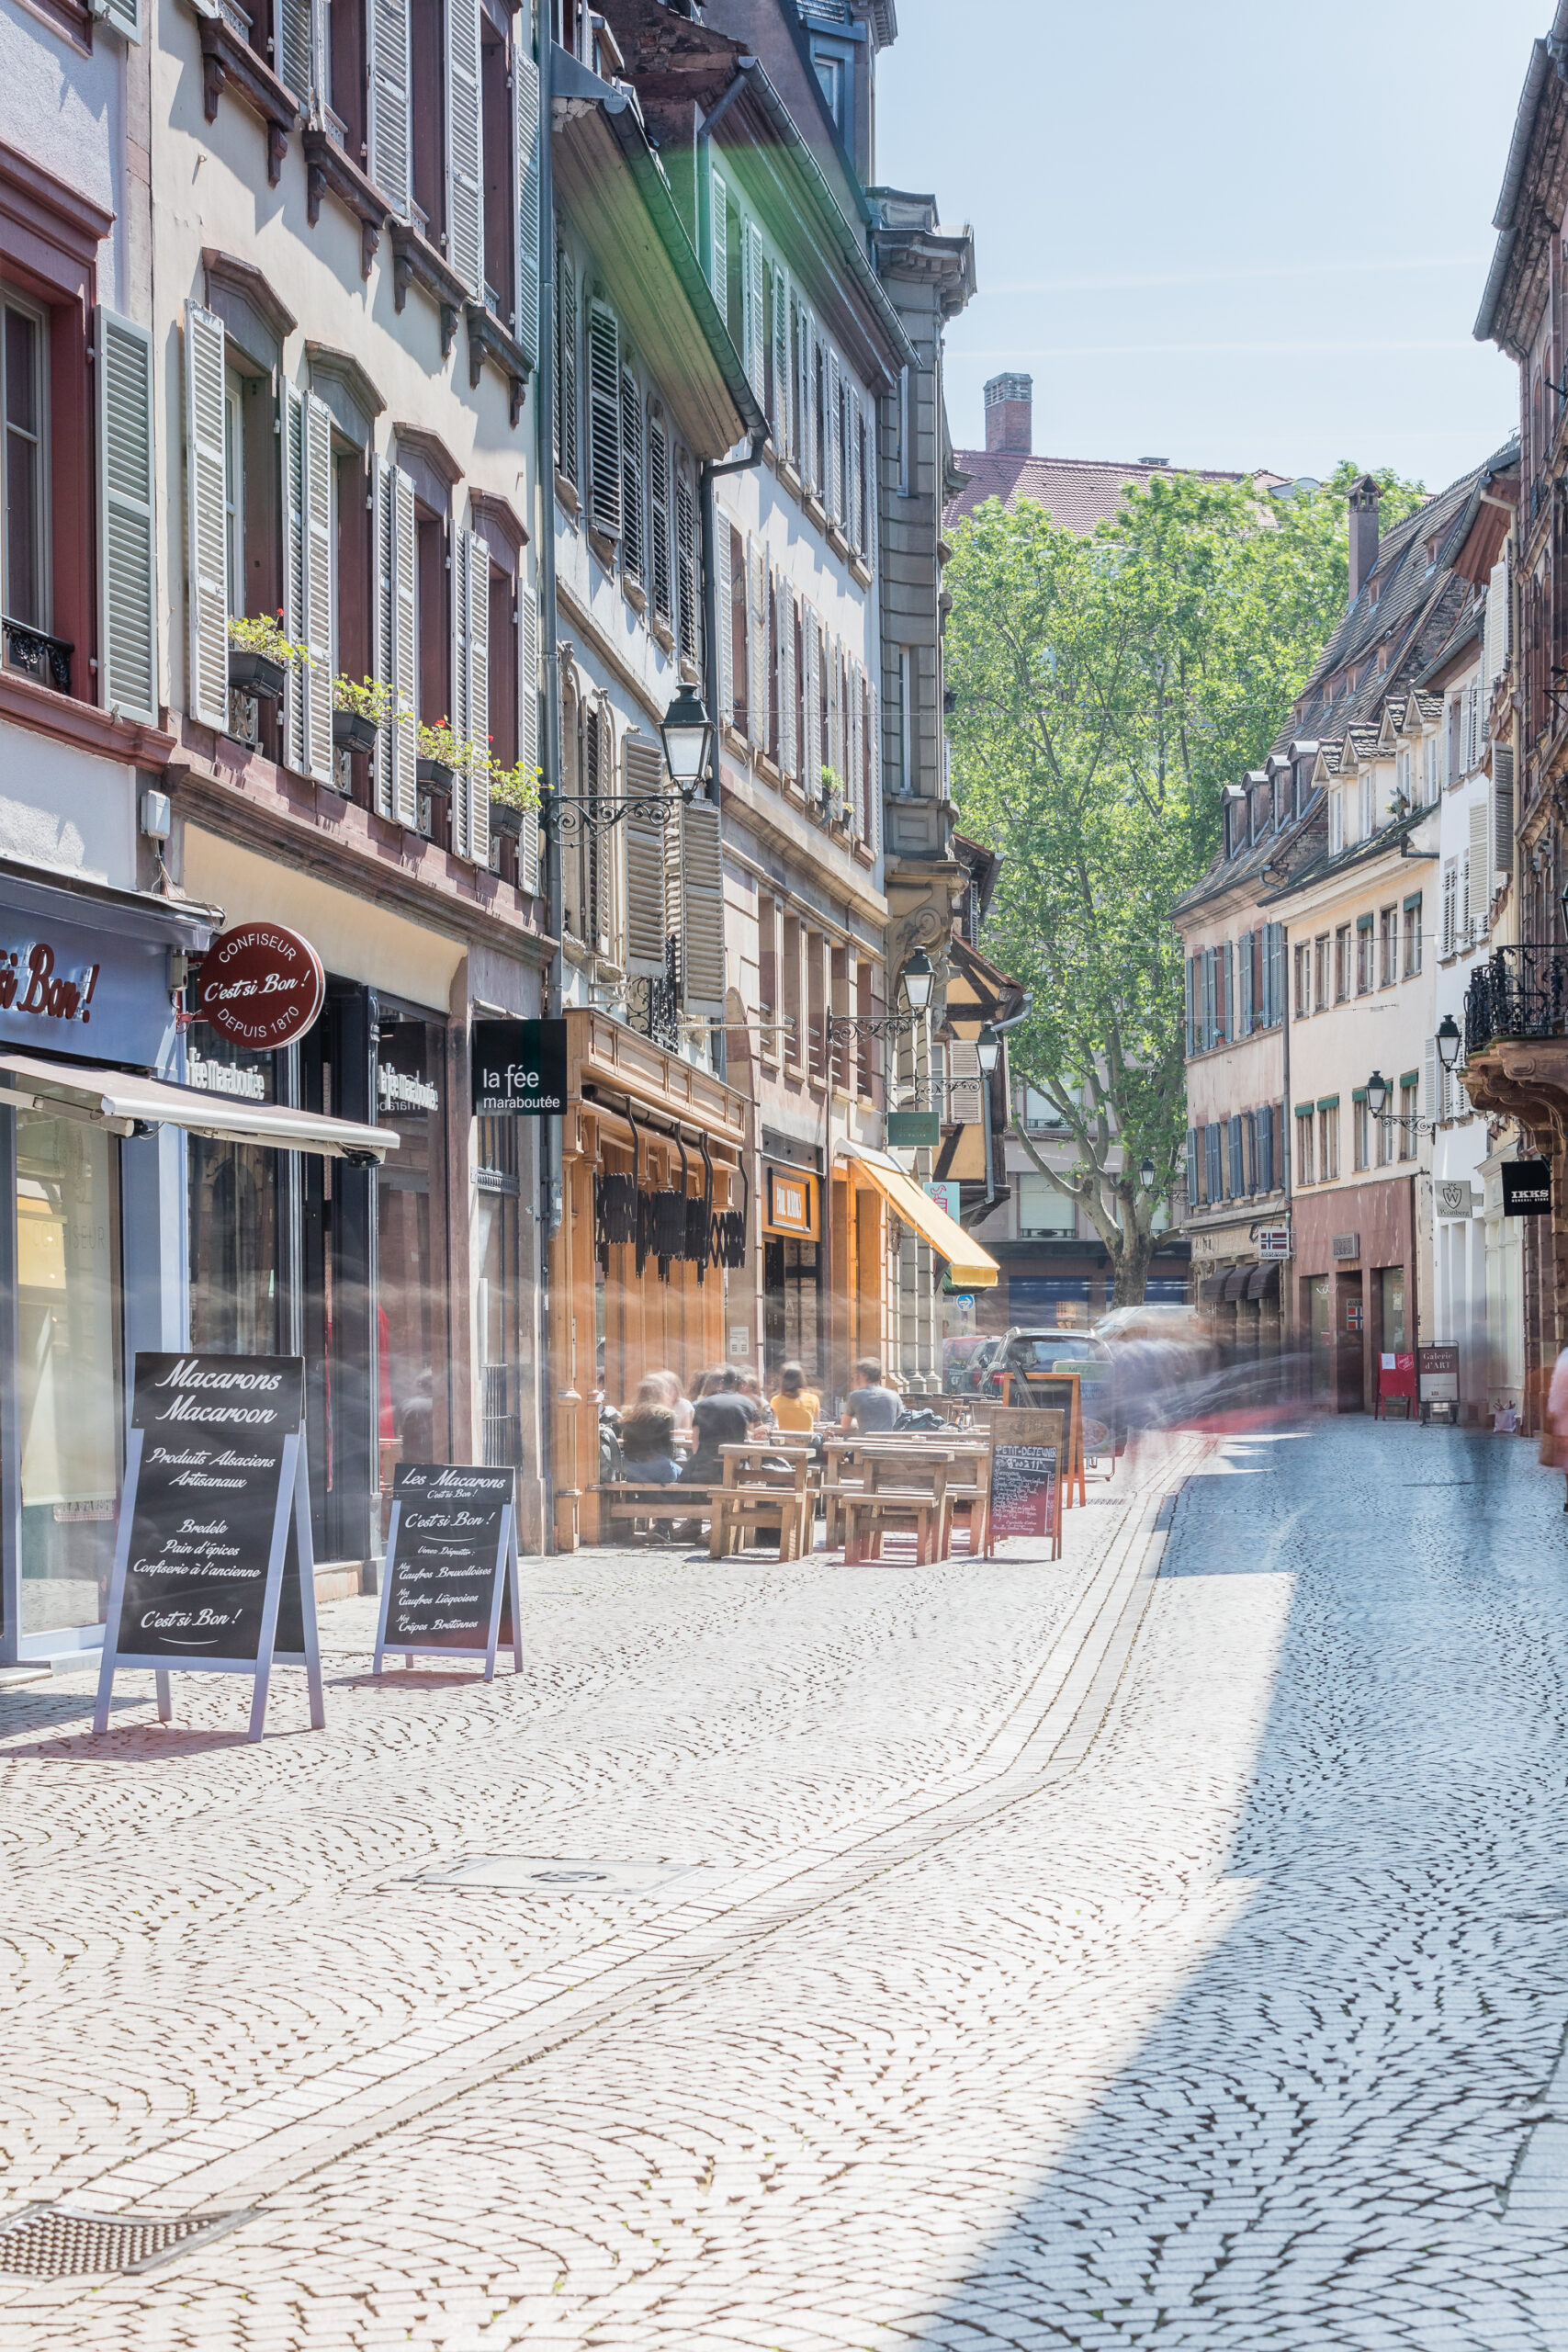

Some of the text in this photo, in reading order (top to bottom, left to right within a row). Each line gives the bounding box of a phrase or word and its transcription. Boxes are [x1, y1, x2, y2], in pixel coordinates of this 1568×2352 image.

[219, 933, 297, 963] CONFISEUR
[204, 969, 310, 1002] C'est si Bon !
[217, 1006, 299, 1038] DEPUIS 1870
[483, 1064, 539, 1098] la fée
[483, 1095, 560, 1109] maraboutée
[1511, 1189, 1550, 1199] IKKS
[154, 1359, 282, 1390] Macarons
[154, 1394, 278, 1424] Macaroon
[145, 1447, 276, 1468] Produits Alsaciens
[168, 1470, 248, 1488] Artisanaux
[401, 1467, 506, 1488] Les Macarons
[176, 1519, 229, 1534] Bredele
[405, 1510, 496, 1528] C'est si Bon !
[160, 1539, 241, 1559] Pain d'épices
[417, 1545, 439, 1555] Venez
[133, 1558, 262, 1577] Confiserie à l'ancienne
[397, 1562, 411, 1572] Nos
[399, 1565, 492, 1582] Gaufres Bruxelloises
[396, 1588, 410, 1597] Nos
[398, 1593, 433, 1608] Gaufres
[141, 1608, 243, 1628] C'est si Bon !
[396, 1613, 410, 1623] Nos
[398, 1618, 479, 1634] Crêpes Bretonnes
